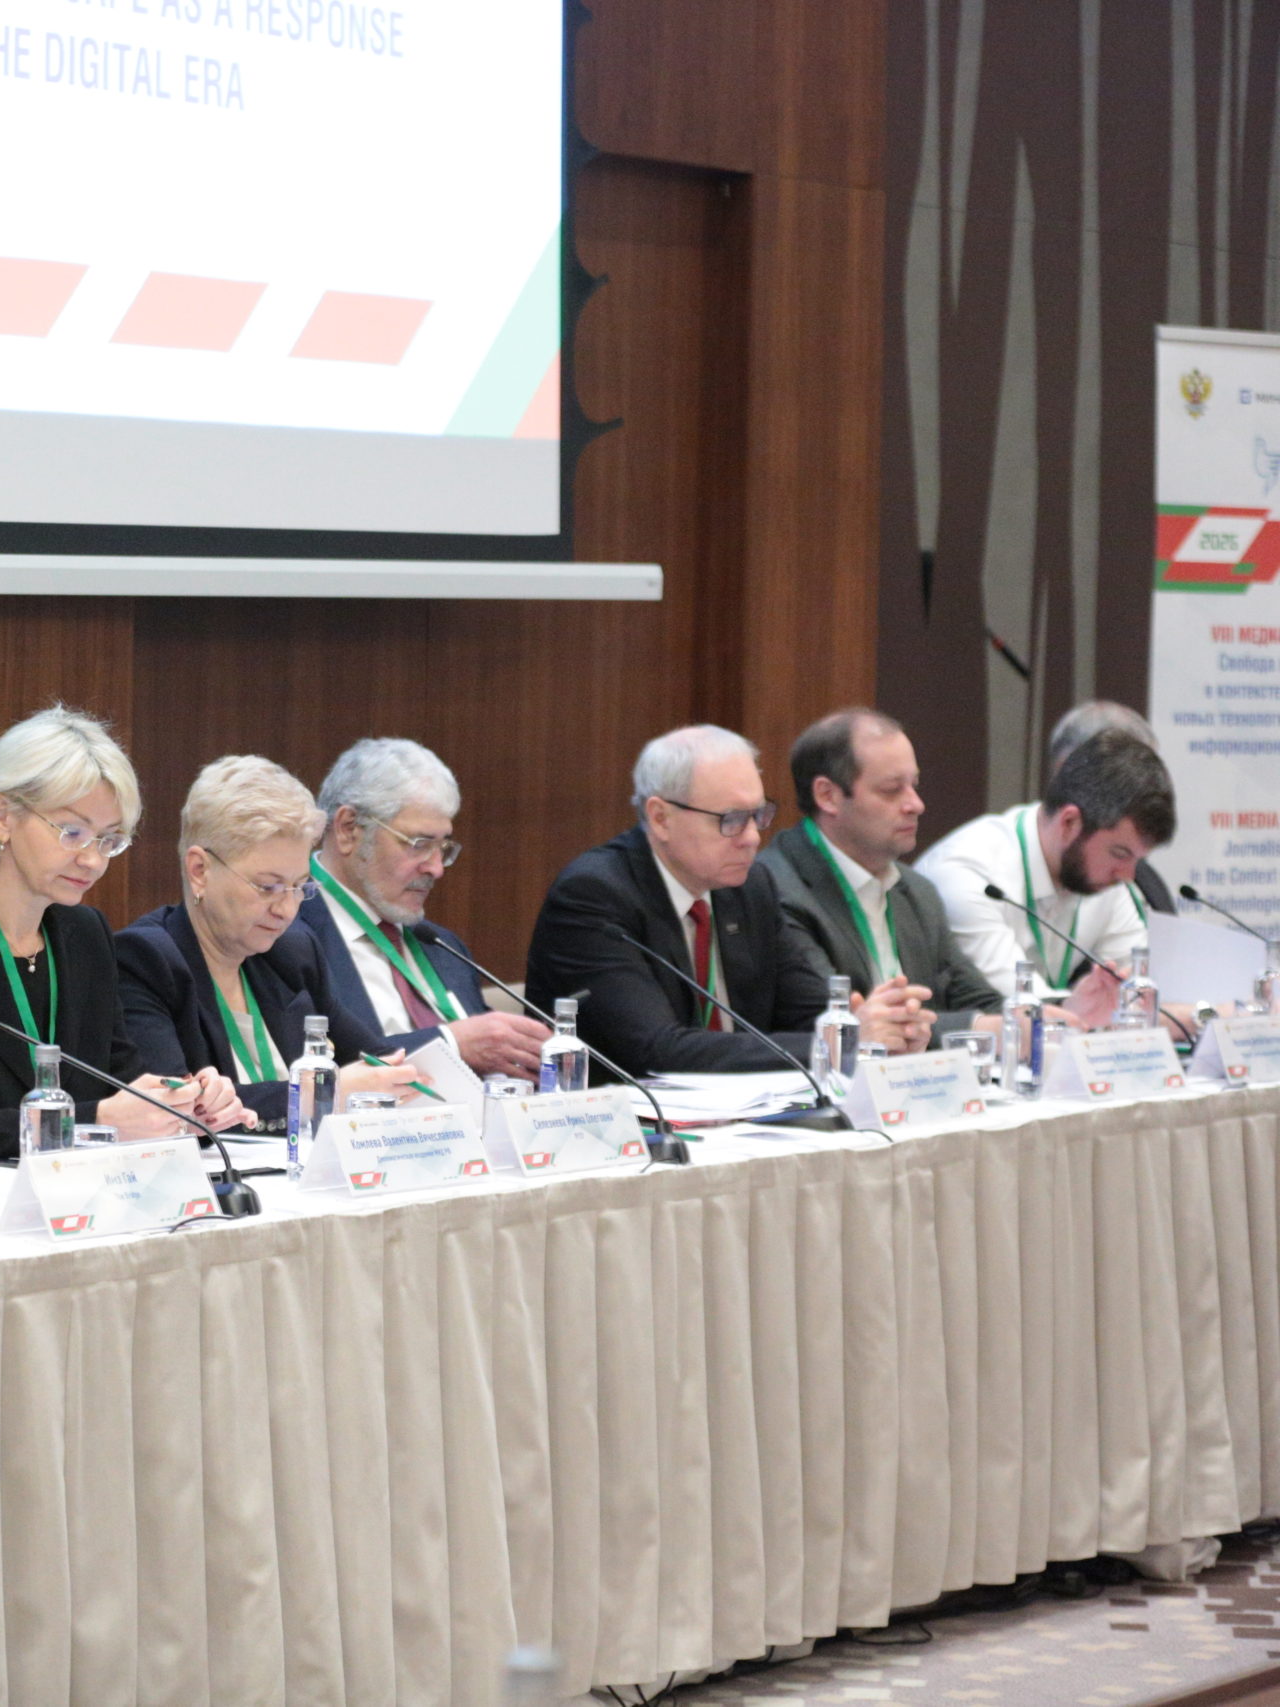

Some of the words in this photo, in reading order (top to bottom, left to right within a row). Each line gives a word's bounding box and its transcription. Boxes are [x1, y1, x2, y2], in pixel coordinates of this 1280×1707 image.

[245, 0, 405, 59] RESPONSE
[45, 31, 171, 100] DIGITAL
[184, 53, 246, 111] ERA
